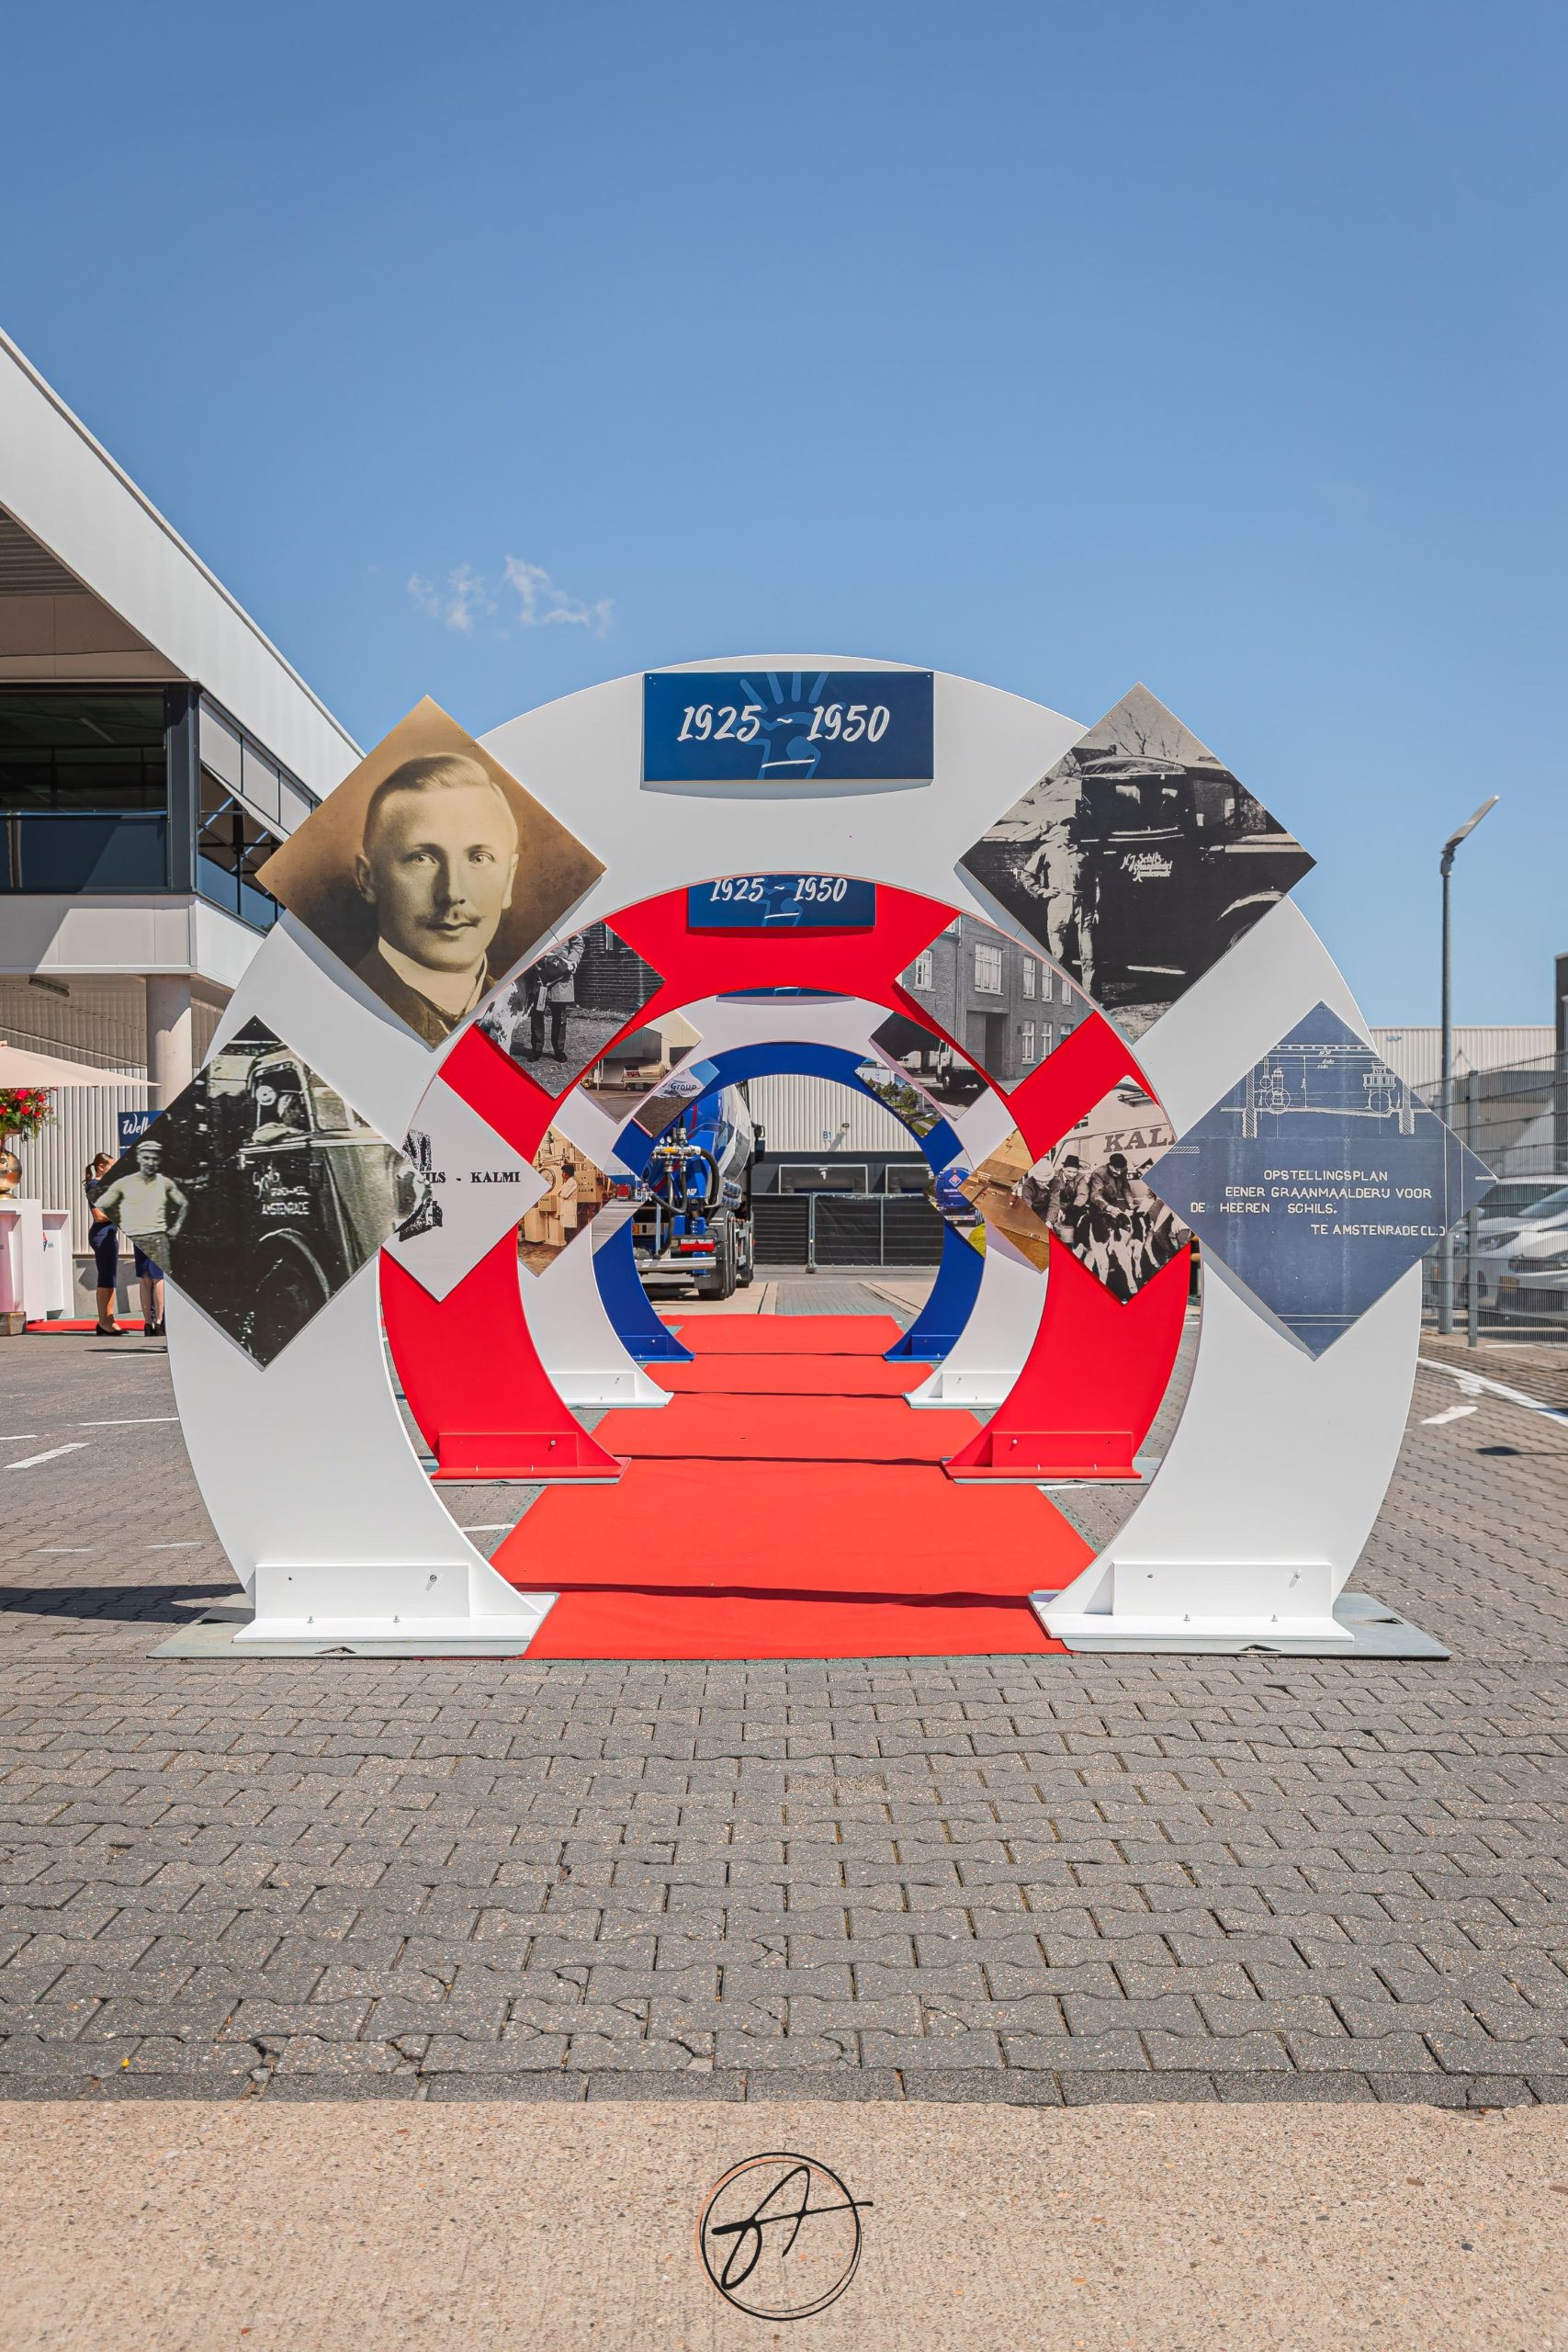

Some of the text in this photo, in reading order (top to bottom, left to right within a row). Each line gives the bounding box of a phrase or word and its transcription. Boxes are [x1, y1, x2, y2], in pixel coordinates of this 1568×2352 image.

[677, 704, 761, 742] 1925
[807, 704, 890, 742] 1950
[710, 878, 765, 902] 1925
[794, 876, 848, 902] 1950
[470, 1171, 521, 1183] KALMI
[1264, 1170, 1388, 1182] OPSTELLINGSPLAN
[1225, 1186, 1266, 1197] EENER
[1395, 1188, 1432, 1199] VOOR
[1190, 1202, 1205, 1213] DE
[1220, 1203, 1270, 1213] HEEREN
[1311, 1224, 1328, 1235] TE
